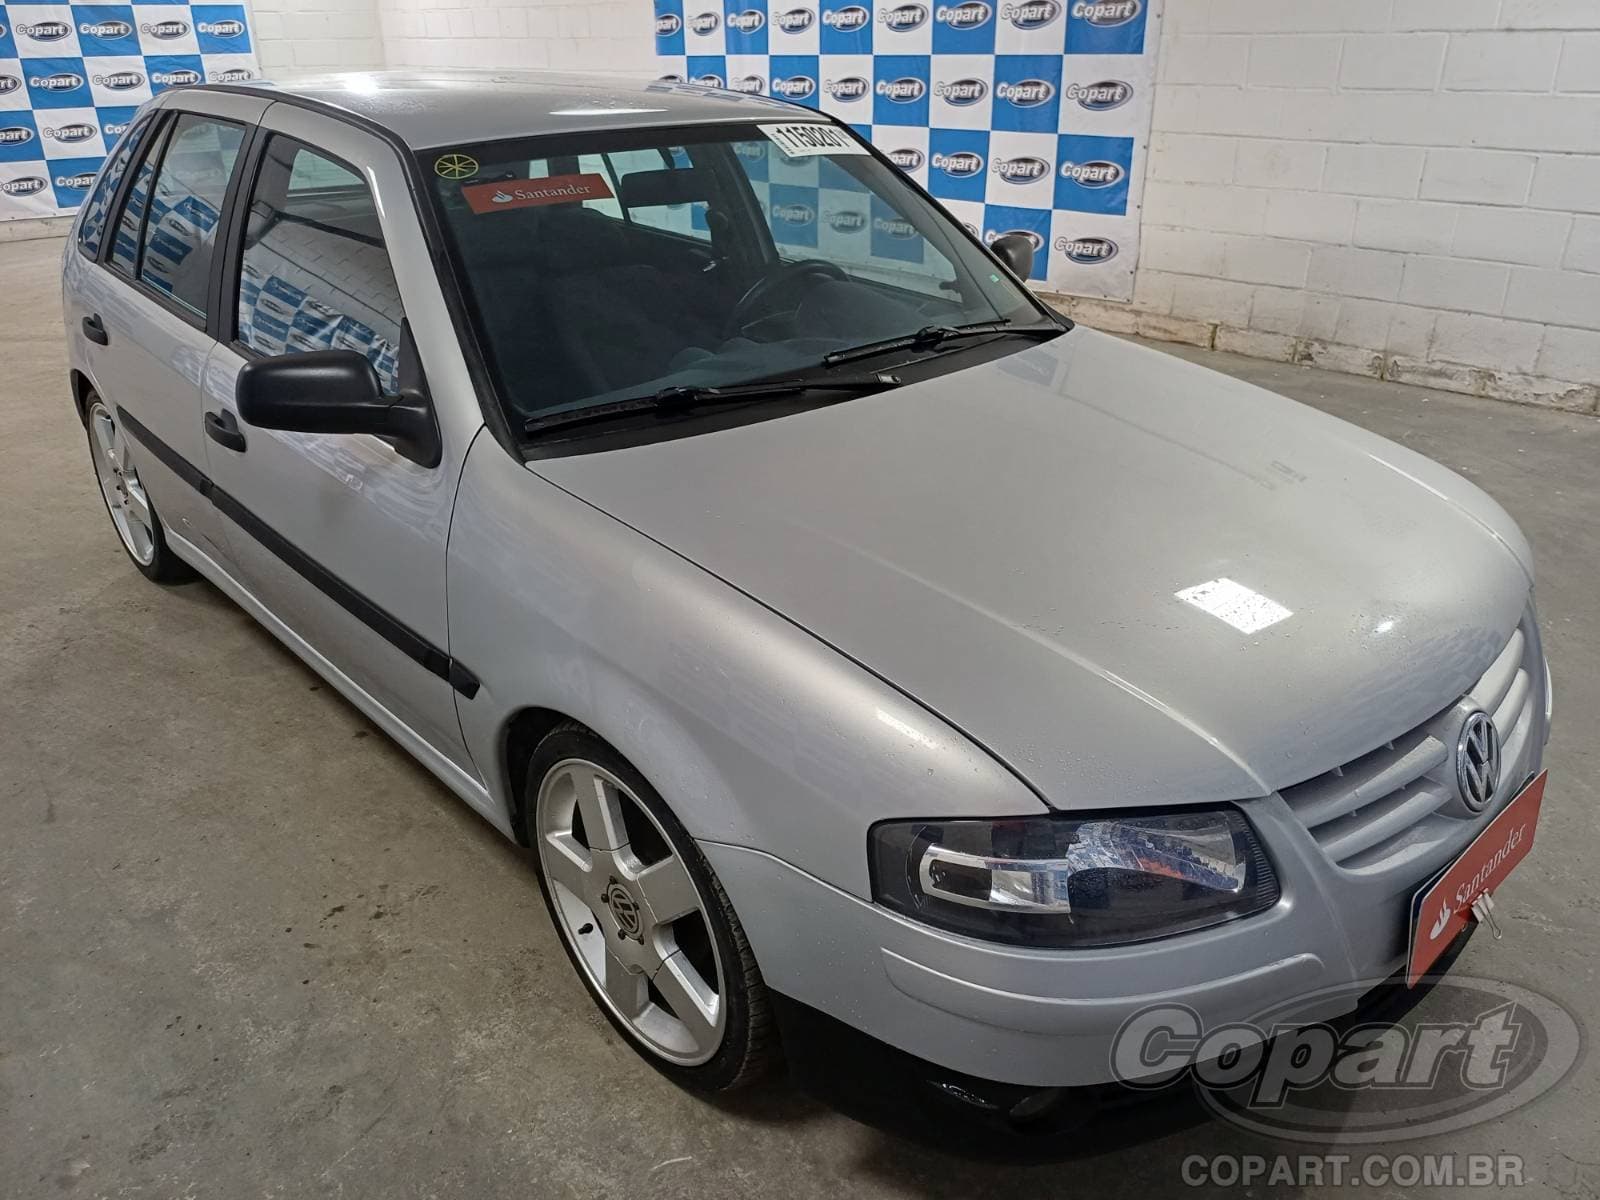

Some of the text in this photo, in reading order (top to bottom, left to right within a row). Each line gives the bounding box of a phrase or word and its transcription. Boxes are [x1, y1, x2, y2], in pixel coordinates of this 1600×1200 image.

[878, 6, 922, 24] Copart
[936, 4, 986, 22] Copart
[1001, 3, 1052, 22] Copart
[1072, 0, 1131, 19] Copart
[656, 18, 677, 32] part
[823, 9, 864, 27] Copart
[16, 23, 65, 38] Copart
[80, 23, 127, 38] Copart
[141, 23, 185, 37] Copart
[197, 22, 240, 35] Copart
[30, 76, 78, 90] Copart
[93, 75, 138, 89] Copart
[151, 72, 196, 85] Copart
[208, 70, 248, 81] Copart
[772, 79, 811, 96] Copart
[824, 80, 865, 97] Copart
[876, 81, 921, 97] Copart
[934, 81, 981, 100] Copart
[997, 83, 1046, 101] Copart
[1067, 84, 1122, 103] Copart
[0, 130, 29, 142] part
[43, 126, 90, 140] Copart
[932, 153, 978, 170] Copart
[992, 158, 1041, 176] Copart
[1061, 162, 1116, 182] Copart
[0, 179, 39, 193] opart
[56, 176, 95, 190] Copar
[514, 185, 592, 201] Santander
[773, 205, 809, 221] Copart
[1055, 237, 1109, 257] Copart
[1453, 823, 1526, 908] Santander
